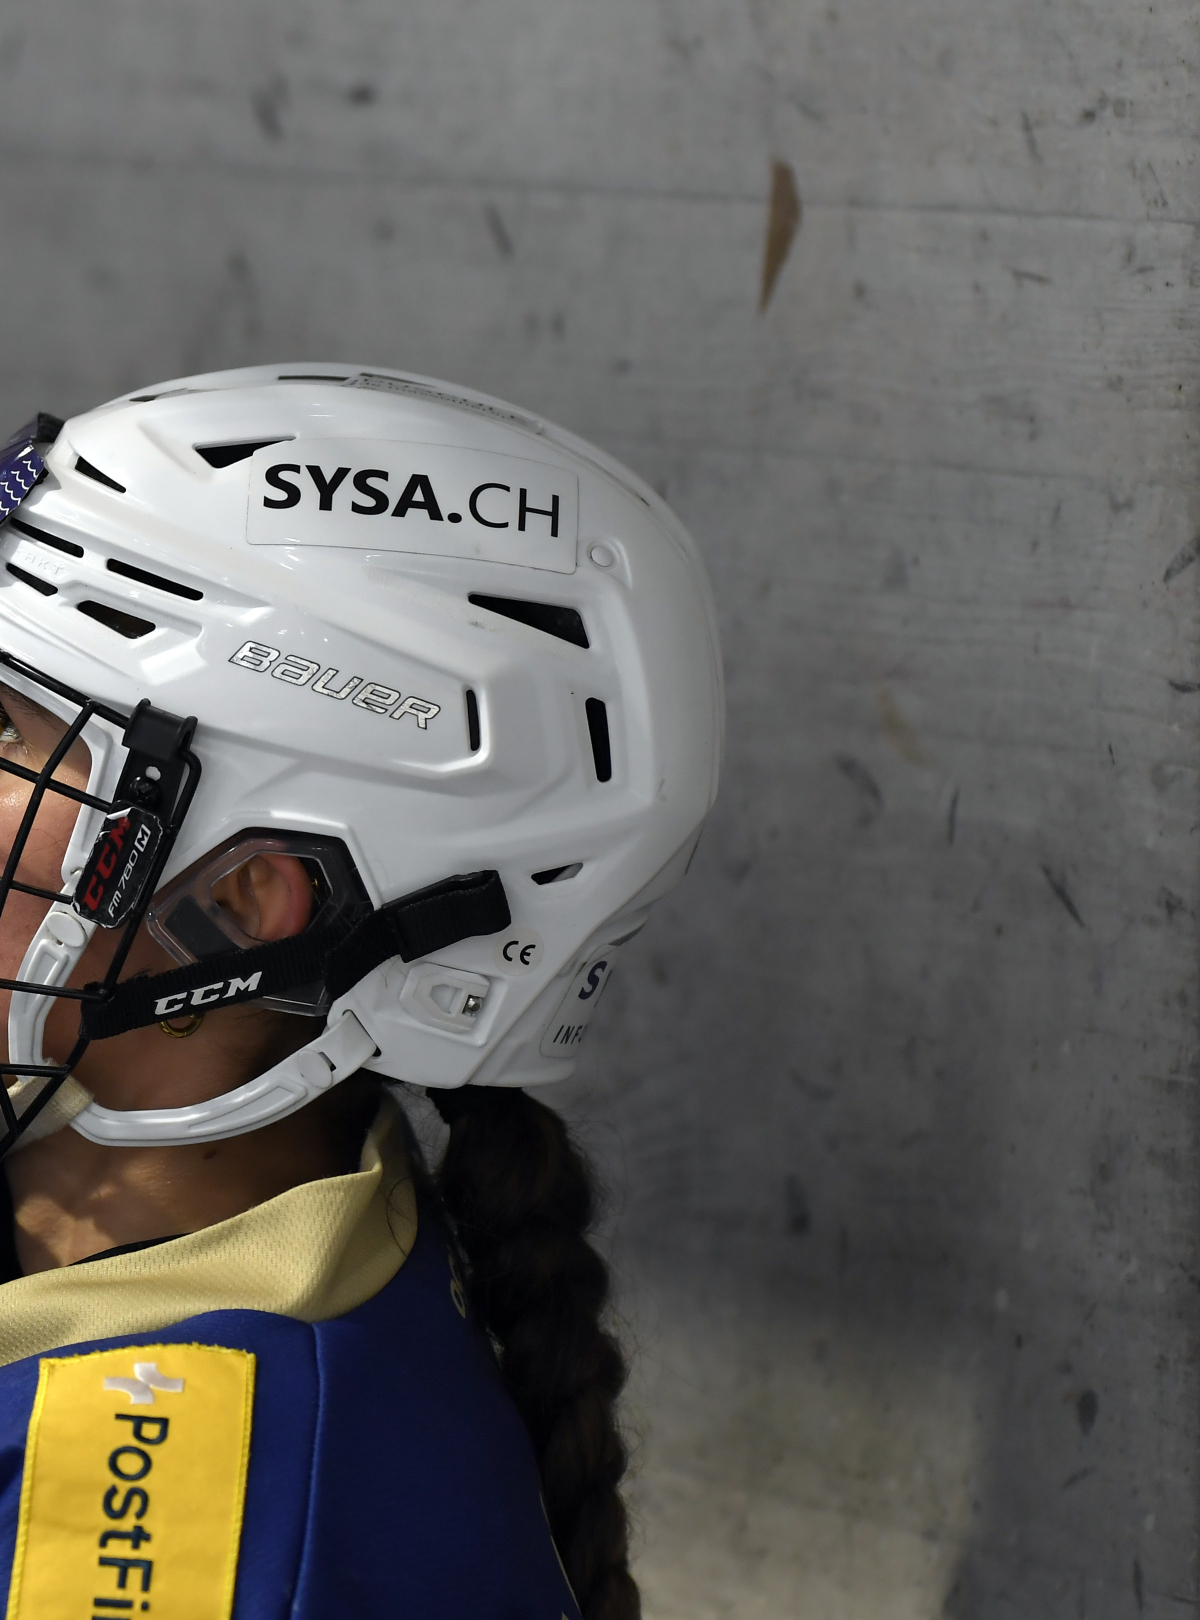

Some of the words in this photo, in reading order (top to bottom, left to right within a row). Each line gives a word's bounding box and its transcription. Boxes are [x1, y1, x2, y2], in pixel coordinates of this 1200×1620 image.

[263, 463, 560, 538] SYSA.CH
[82, 816, 131, 911] CCM
[154, 971, 263, 1016] CCM
[91, 1413, 170, 1620] PostFi
